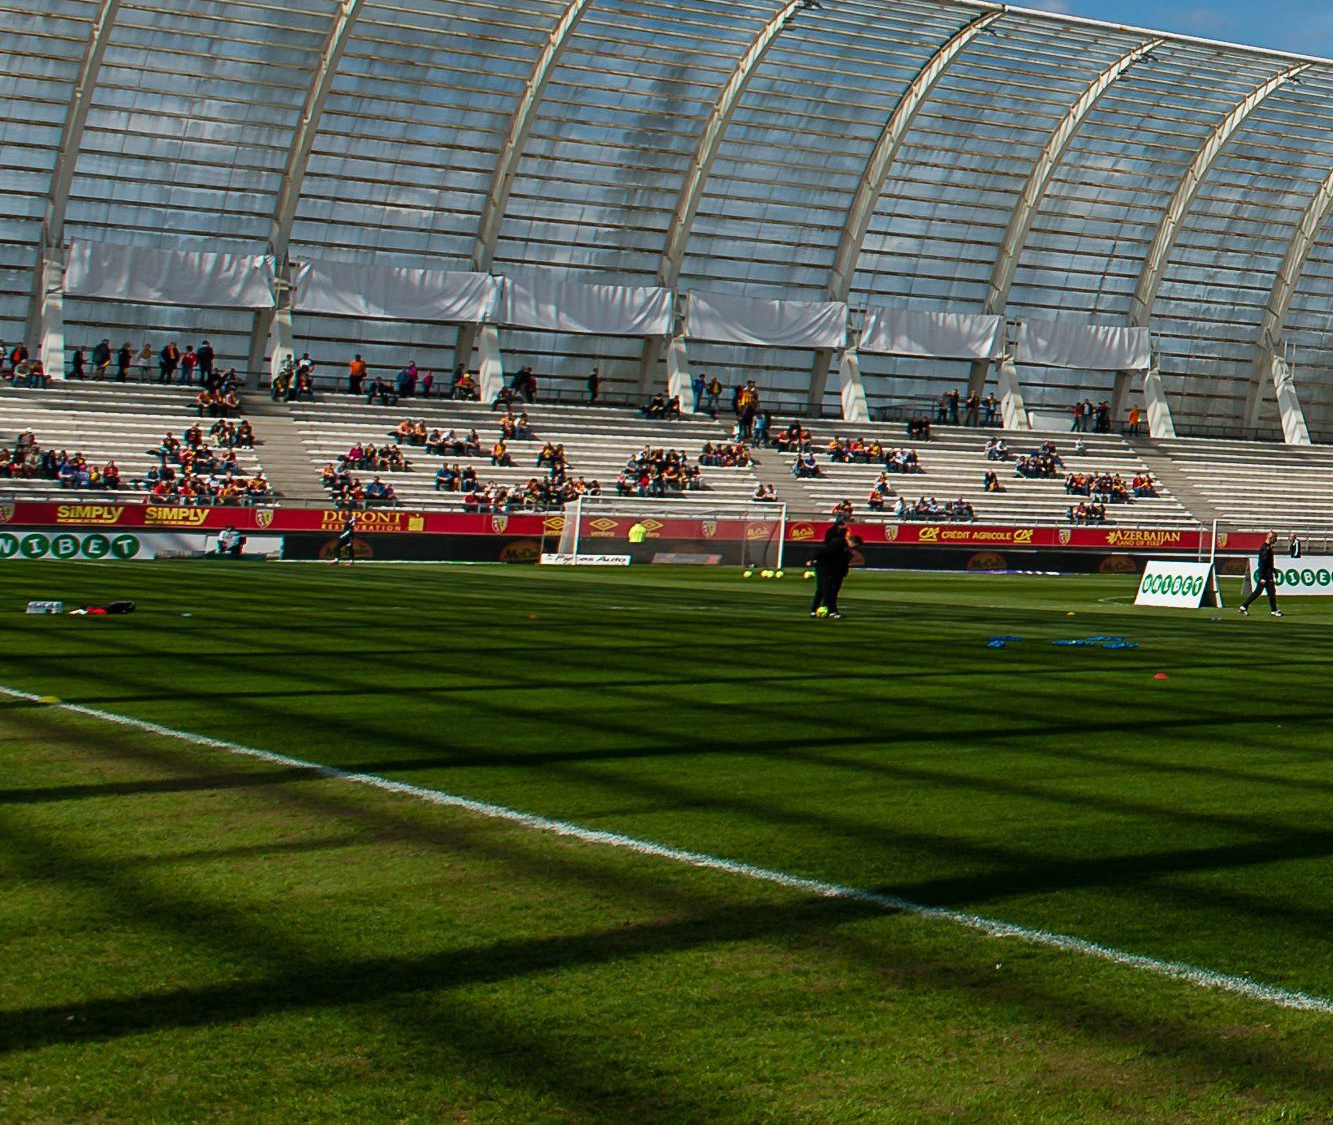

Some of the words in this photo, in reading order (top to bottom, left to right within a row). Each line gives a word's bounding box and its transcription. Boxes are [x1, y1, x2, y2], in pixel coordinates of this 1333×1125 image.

[321, 523, 401, 531] RESTURATION
[972, 532, 1012, 541] AGRICOLE
[0, 533, 139, 558] NIBET
[1141, 574, 1203, 596] UNIBET
